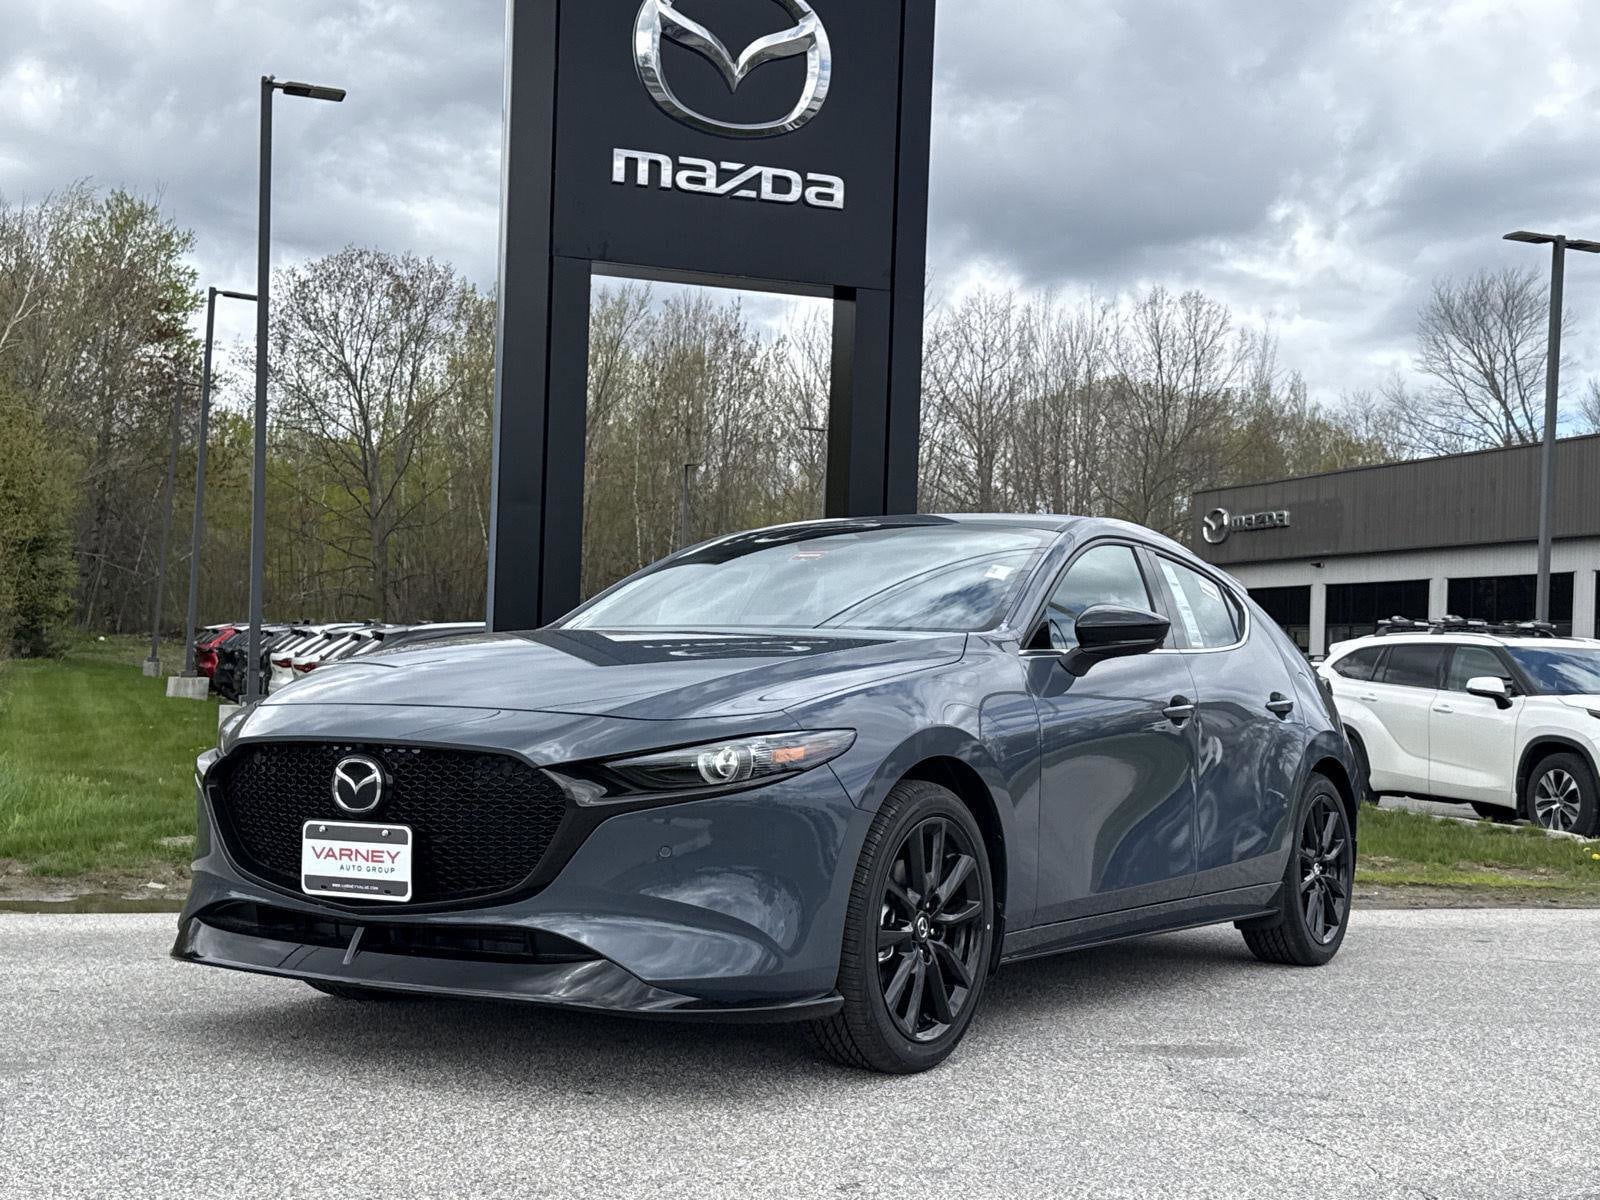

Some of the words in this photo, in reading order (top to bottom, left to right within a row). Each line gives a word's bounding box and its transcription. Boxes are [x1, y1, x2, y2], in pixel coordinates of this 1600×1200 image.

[611, 147, 845, 210] mazda
[311, 846, 401, 864] VARNEY
[340, 864, 362, 872] AUTO
[366, 866, 395, 874] GROUP
